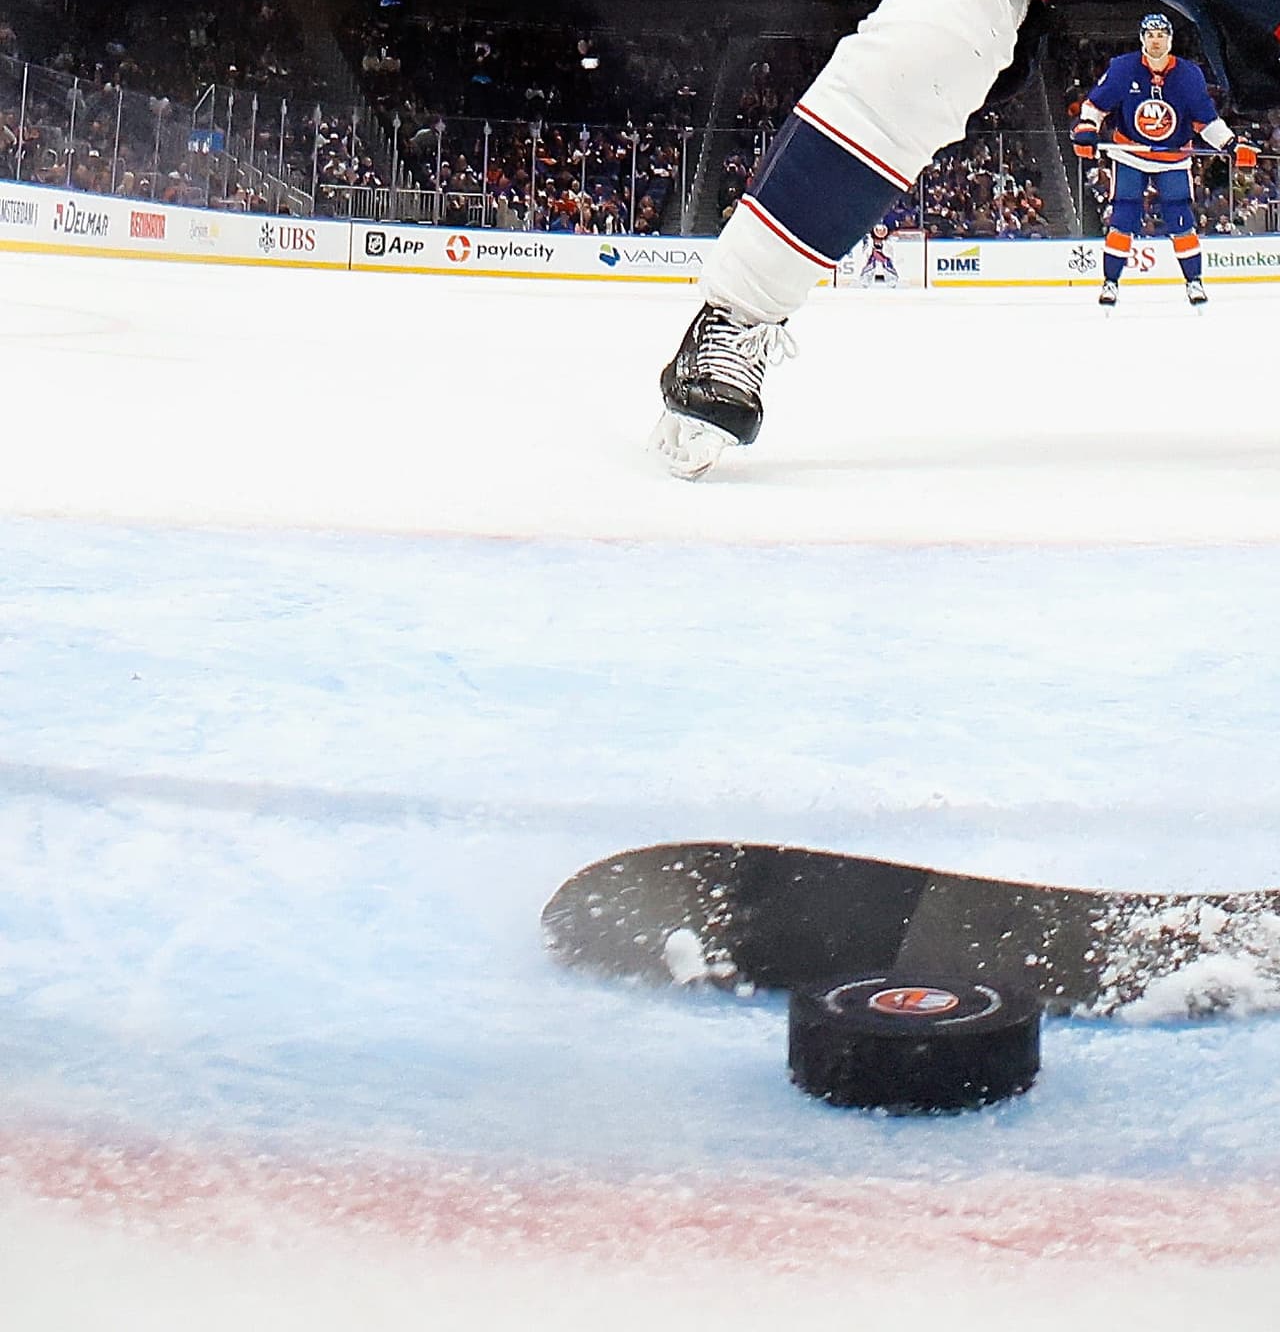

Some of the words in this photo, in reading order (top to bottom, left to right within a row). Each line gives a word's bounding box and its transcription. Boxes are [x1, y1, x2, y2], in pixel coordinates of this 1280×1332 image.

[64, 200, 109, 237] DELMAR
[279, 227, 315, 251] UBS
[476, 241, 554, 263] paylocity
[624, 249, 704, 265] VANDA
[1127, 244, 1156, 270] BS
[937, 258, 980, 271] DIME
